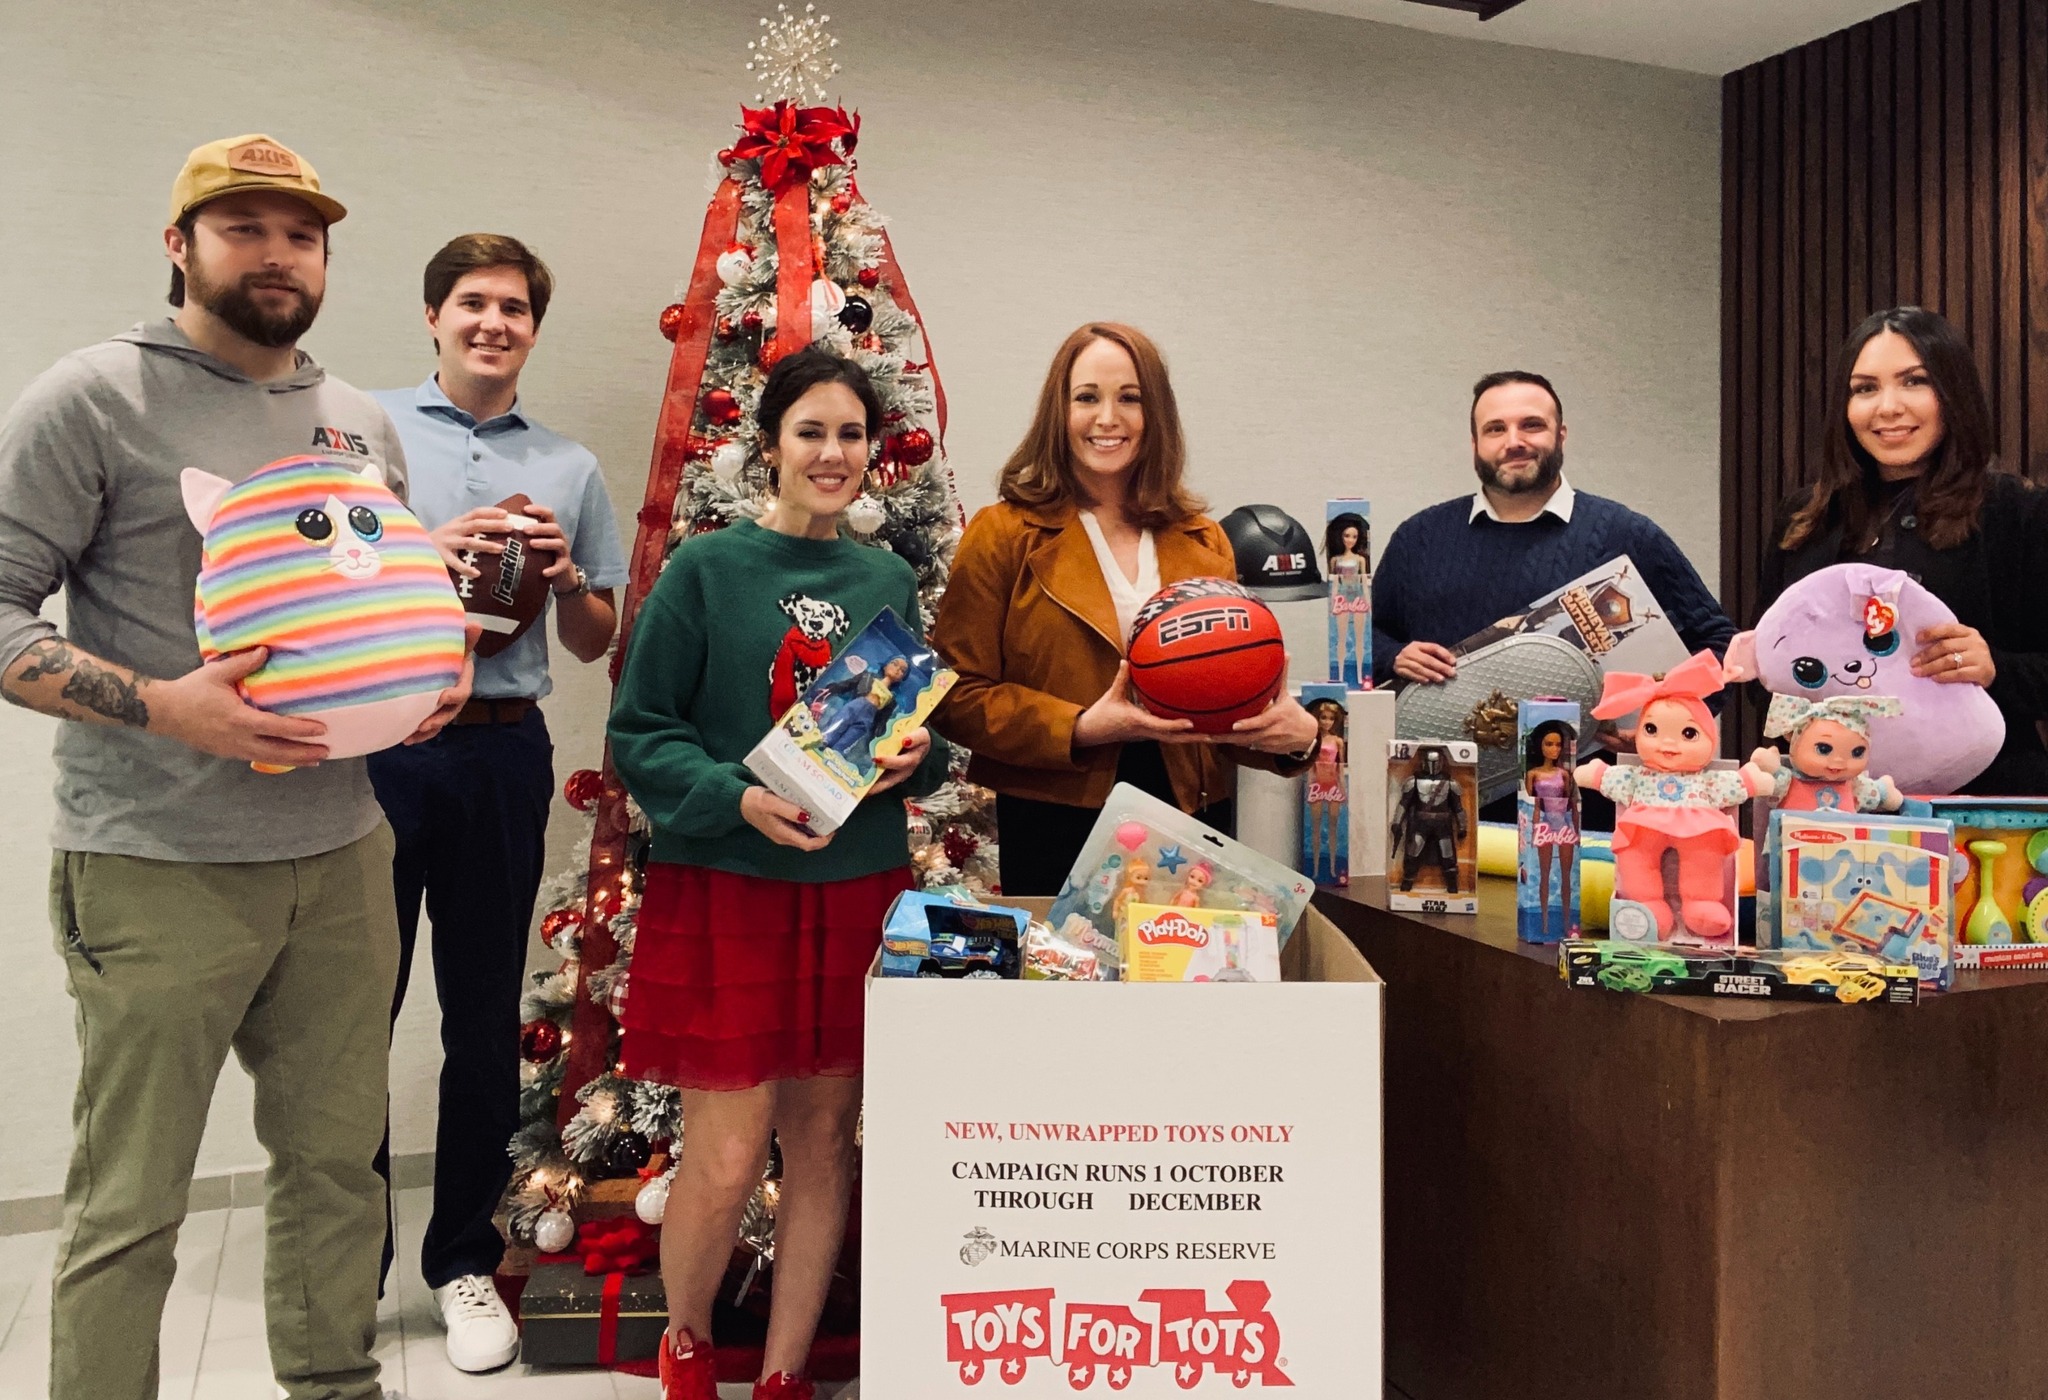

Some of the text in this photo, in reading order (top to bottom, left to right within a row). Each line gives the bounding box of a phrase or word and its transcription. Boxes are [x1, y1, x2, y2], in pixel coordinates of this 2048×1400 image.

[240, 149, 294, 168] AXIS
[312, 427, 369, 456] AXIS
[490, 537, 522, 606] franklin
[1262, 553, 1306, 572] AXIS
[1332, 594, 1369, 615] Barbie
[1158, 607, 1251, 647] ESPN
[1561, 595, 1604, 654] BATTLE SET
[1568, 585, 1613, 653] MEDIEVAL
[1867, 604, 1886, 634] ty
[1308, 783, 1346, 802] Barbie
[1533, 823, 1578, 846] Barbie
[1139, 916, 1208, 945] Play-Doh
[1713, 983, 1771, 995] RACER
[1719, 974, 1766, 985] STREET
[945, 1121, 1294, 1143] NEW, UNWRAPPED TOYS ONLY
[951, 1161, 1284, 1183] CAMPAIGN RUNS 1 OCTOBER
[974, 1190, 1262, 1211] THROUGH DECEMBER
[1000, 1240, 1276, 1260] MARINE CORPS RESERVE
[951, 1302, 1265, 1364] TOYS FOR TOTS
